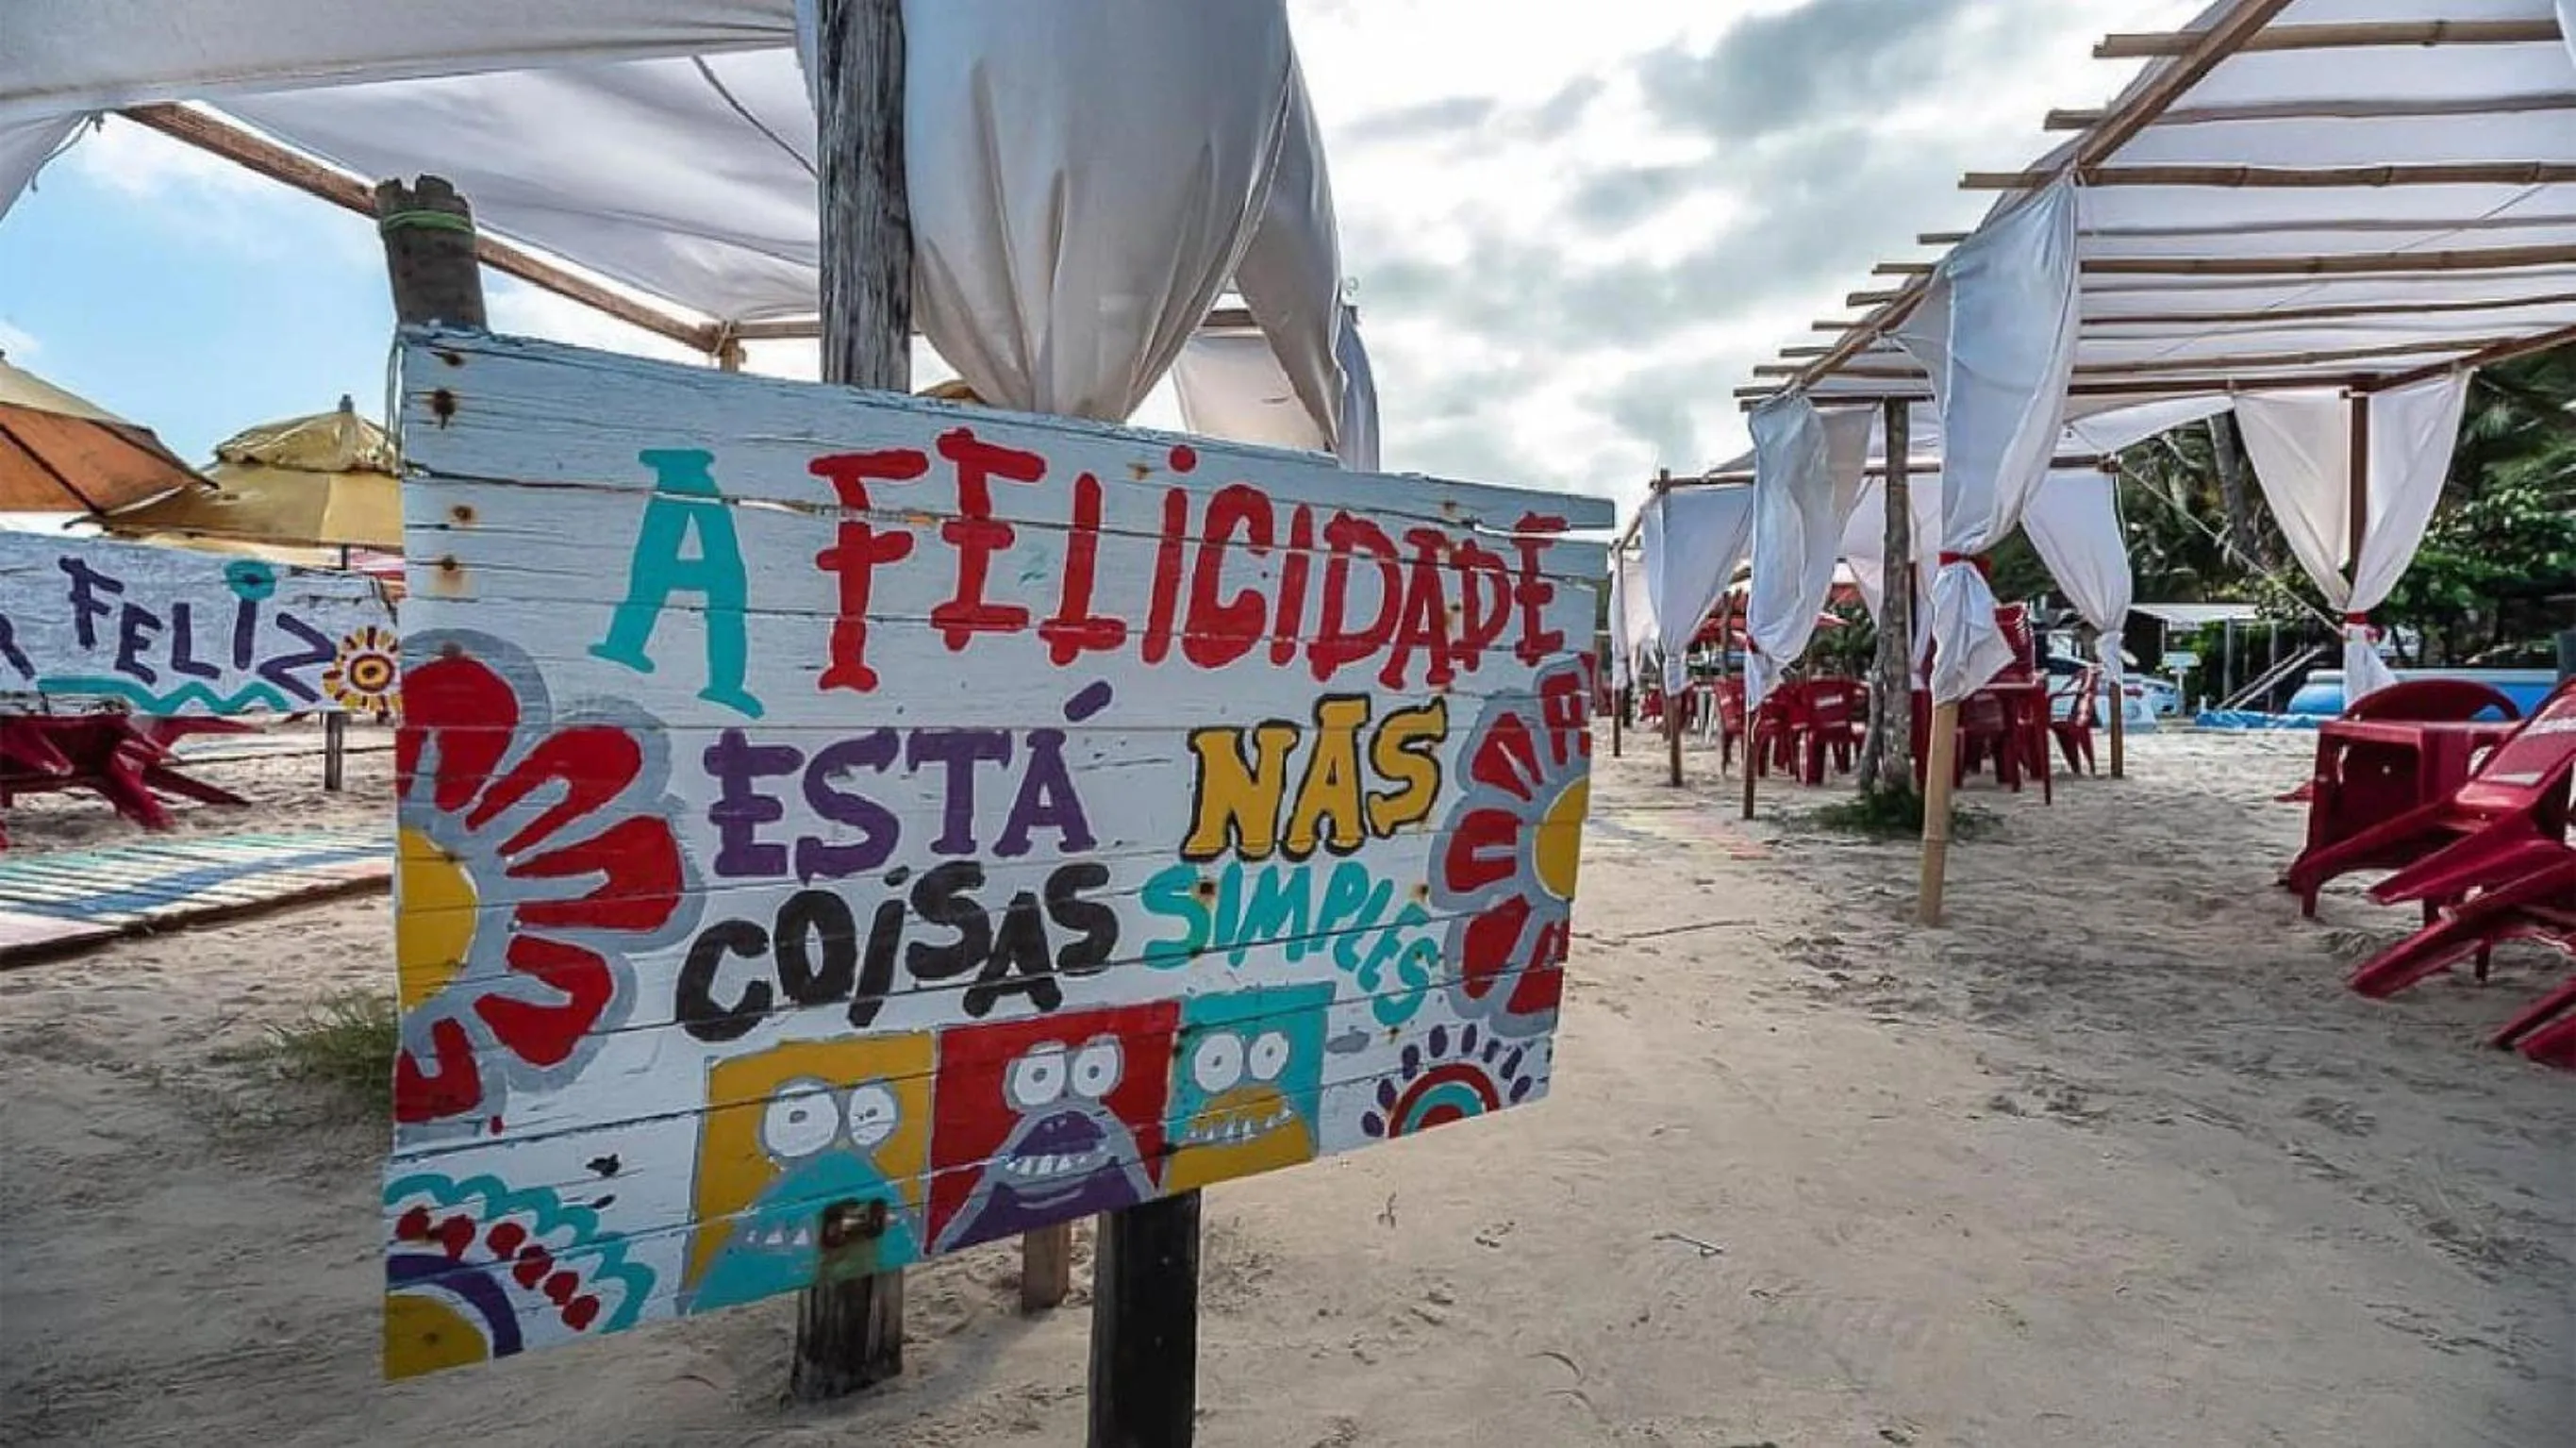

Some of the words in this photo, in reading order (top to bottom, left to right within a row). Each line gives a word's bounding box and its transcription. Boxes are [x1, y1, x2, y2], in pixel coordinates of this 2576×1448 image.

[58, 555, 337, 702] FELIZ
[588, 449, 765, 719] A
[808, 427, 1568, 691] FELICIDADE
[704, 681, 1113, 885] ESTÁ
[1181, 693, 1448, 862] NAS
[1142, 862, 1439, 1026] SIMPLES
